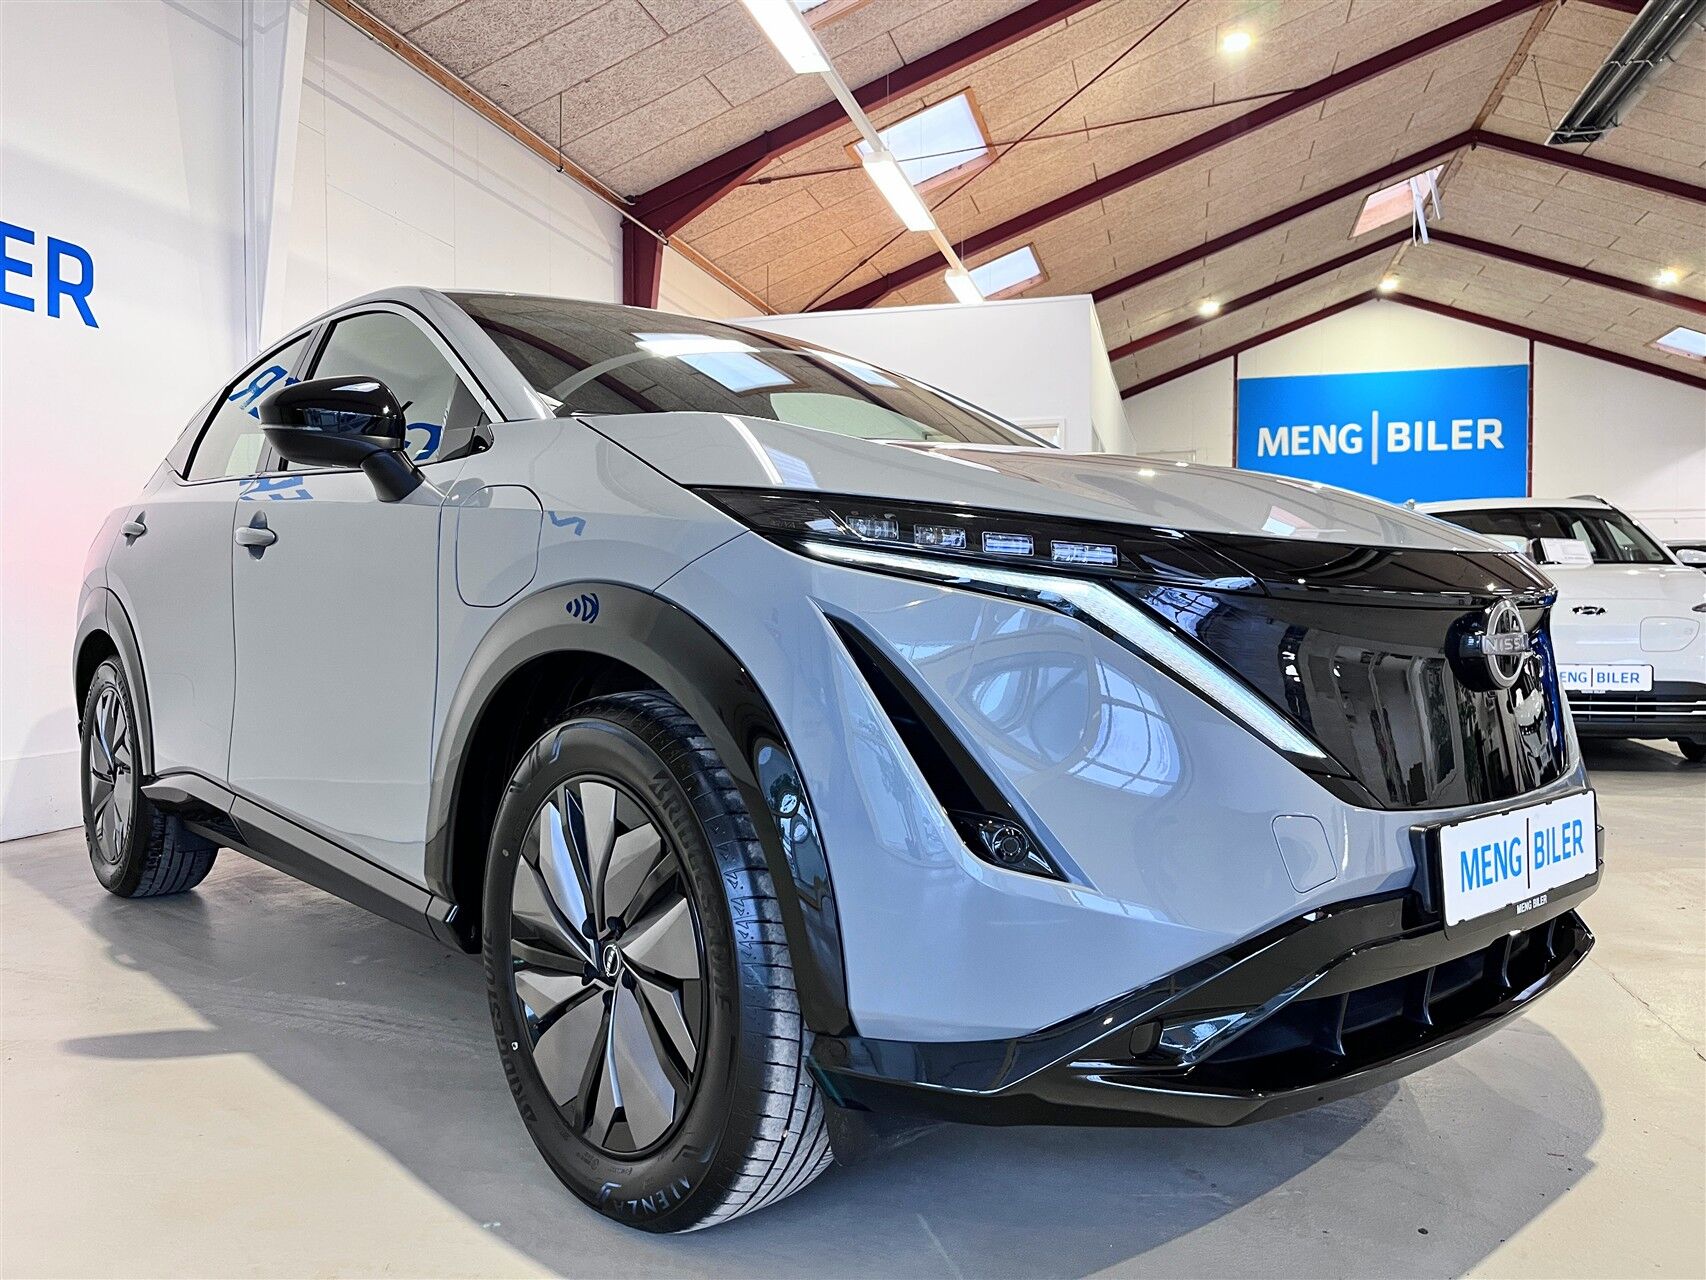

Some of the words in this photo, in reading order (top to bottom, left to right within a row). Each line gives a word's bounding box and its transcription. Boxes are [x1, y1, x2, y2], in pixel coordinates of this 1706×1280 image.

[1257, 423, 1363, 457] MENG
[1387, 418, 1505, 452] BILER
[1484, 636, 1529, 653] NISS
[1559, 671, 1588, 683] ENG
[1596, 672, 1640, 684] BILER
[1460, 837, 1522, 893] MENG
[1534, 819, 1584, 870] BILER
[1516, 899, 1533, 915] MENG
[1532, 894, 1548, 909] BILER
